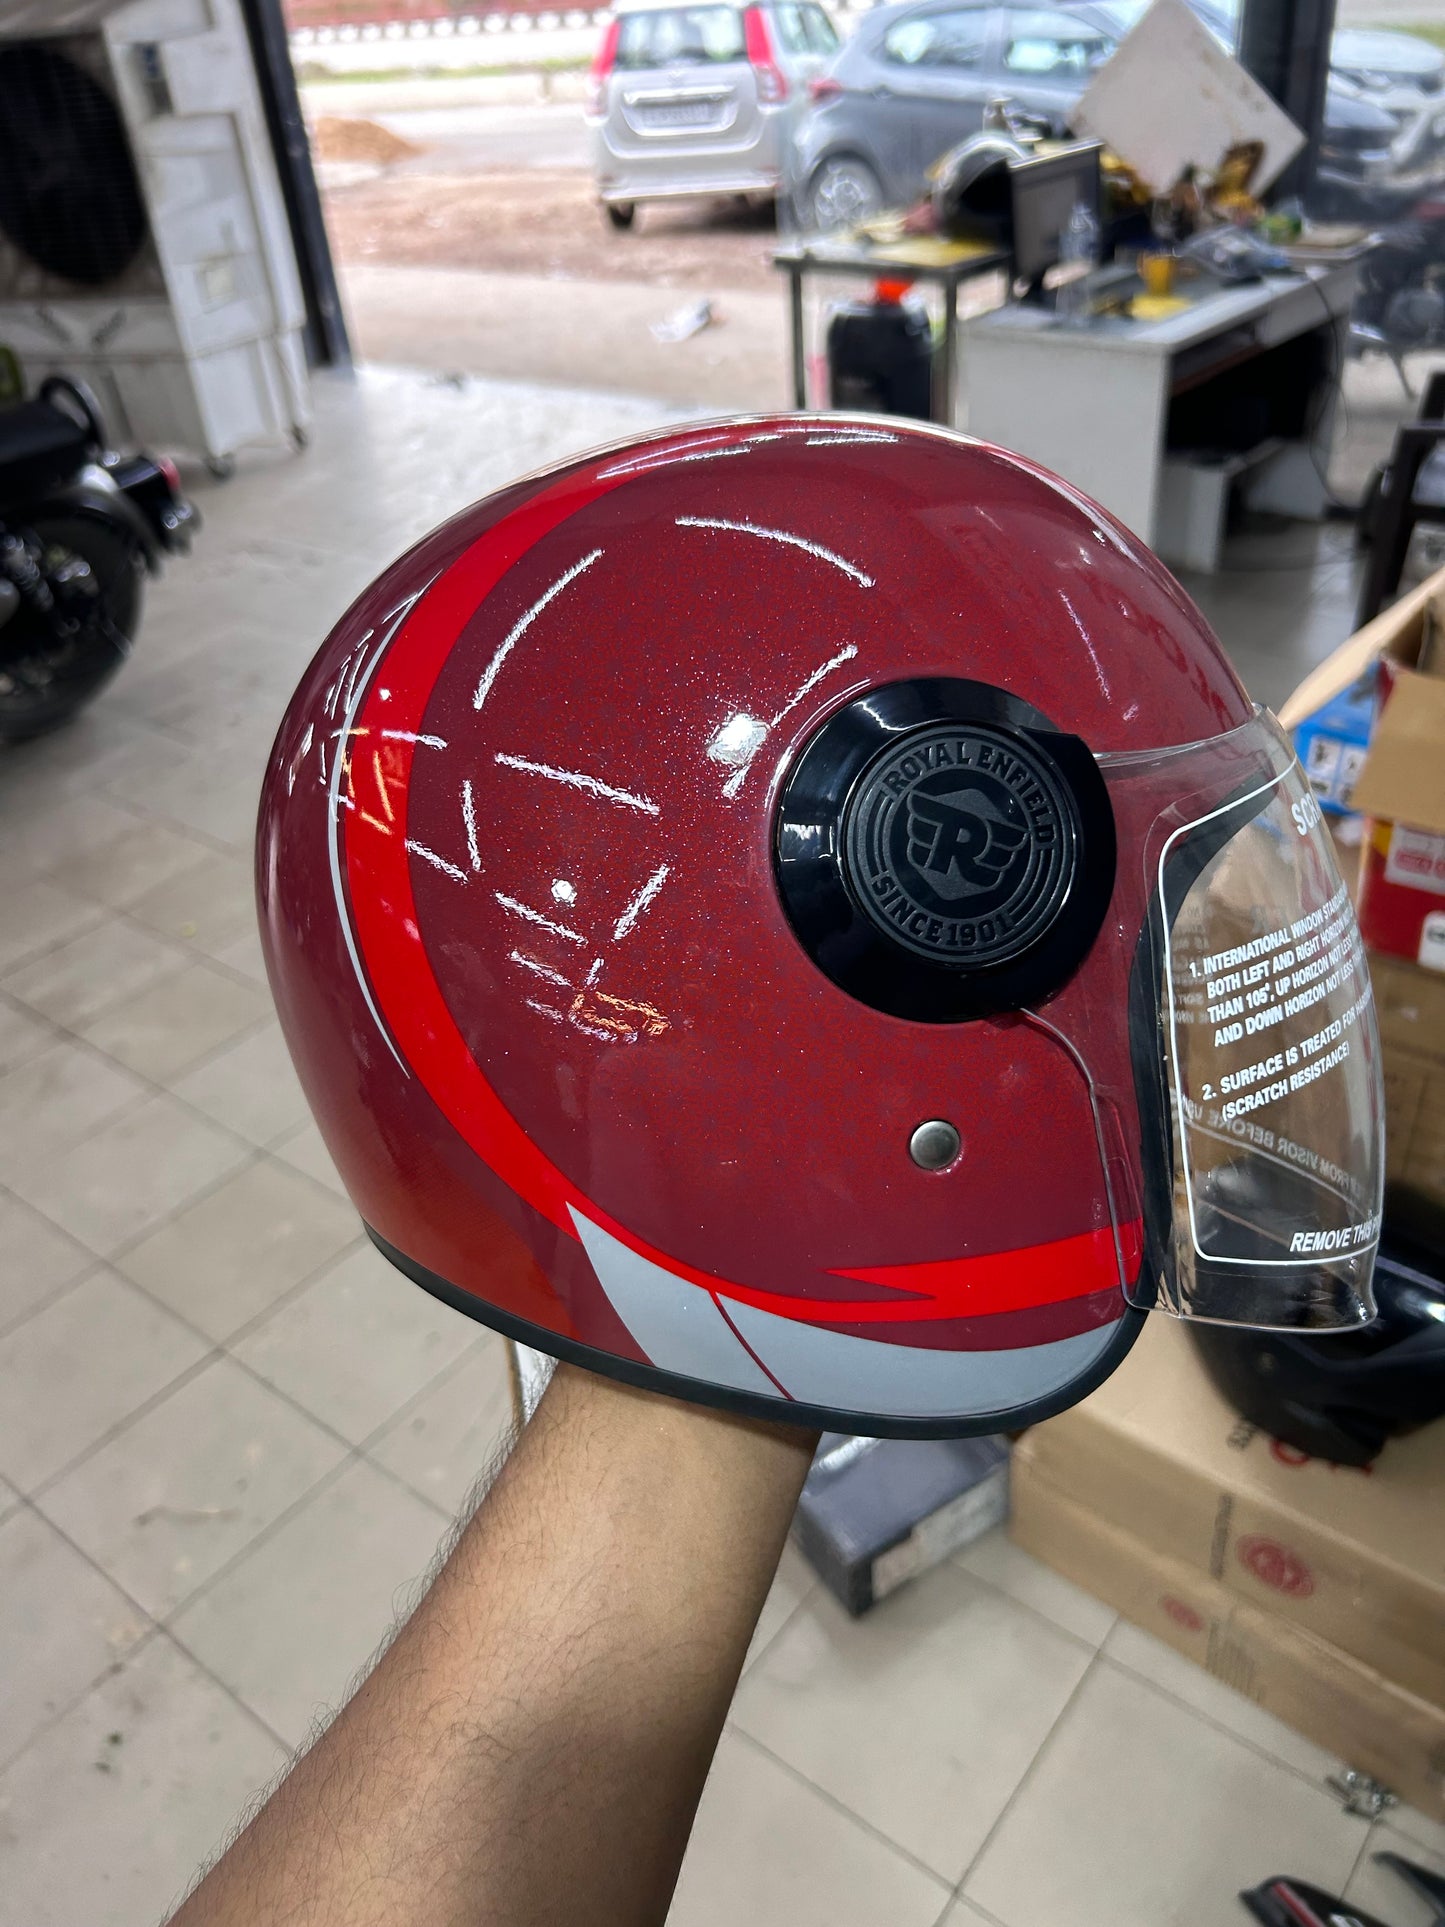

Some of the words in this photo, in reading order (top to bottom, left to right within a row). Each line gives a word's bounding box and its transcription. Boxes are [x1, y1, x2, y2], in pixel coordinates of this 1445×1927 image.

[882, 741, 972, 795] ROYAL
[977, 745, 1055, 845] ENFIELD
[872, 875, 944, 943] SINCE
[947, 910, 1015, 945] 1901
[1189, 961, 1202, 978] 1.
[1203, 927, 1292, 976] INTERNATIONAL
[1290, 908, 1324, 939] WINDOW
[1206, 972, 1241, 999] BOTH
[1243, 960, 1270, 985] LEFT
[1273, 950, 1295, 974] AND
[1295, 935, 1320, 962] RIGHT
[1320, 919, 1345, 947] HORIZON
[1207, 996, 1244, 1023] THAN
[1275, 976, 1291, 996] UP
[1291, 955, 1329, 989] HORIZON
[1328, 944, 1342, 966] NOT
[1341, 934, 1353, 956] LESS
[1214, 1022, 1243, 1047] AND
[1245, 1004, 1283, 1035] DOWN
[1284, 982, 1326, 1017] HORIZON
[1326, 970, 1341, 993] NOT
[1341, 959, 1354, 981] LESS
[1201, 1083, 1217, 1100] 2.
[1219, 1053, 1284, 1094] SURFACE
[1285, 1047, 1299, 1066] IS
[1299, 1019, 1341, 1058] TREATED
[1342, 1006, 1356, 1029] FOR
[1221, 1079, 1288, 1122] (SCRATCH
[1290, 1040, 1350, 1091] RESISTANCE)
[1289, 1226, 1352, 1252] REMOVE
